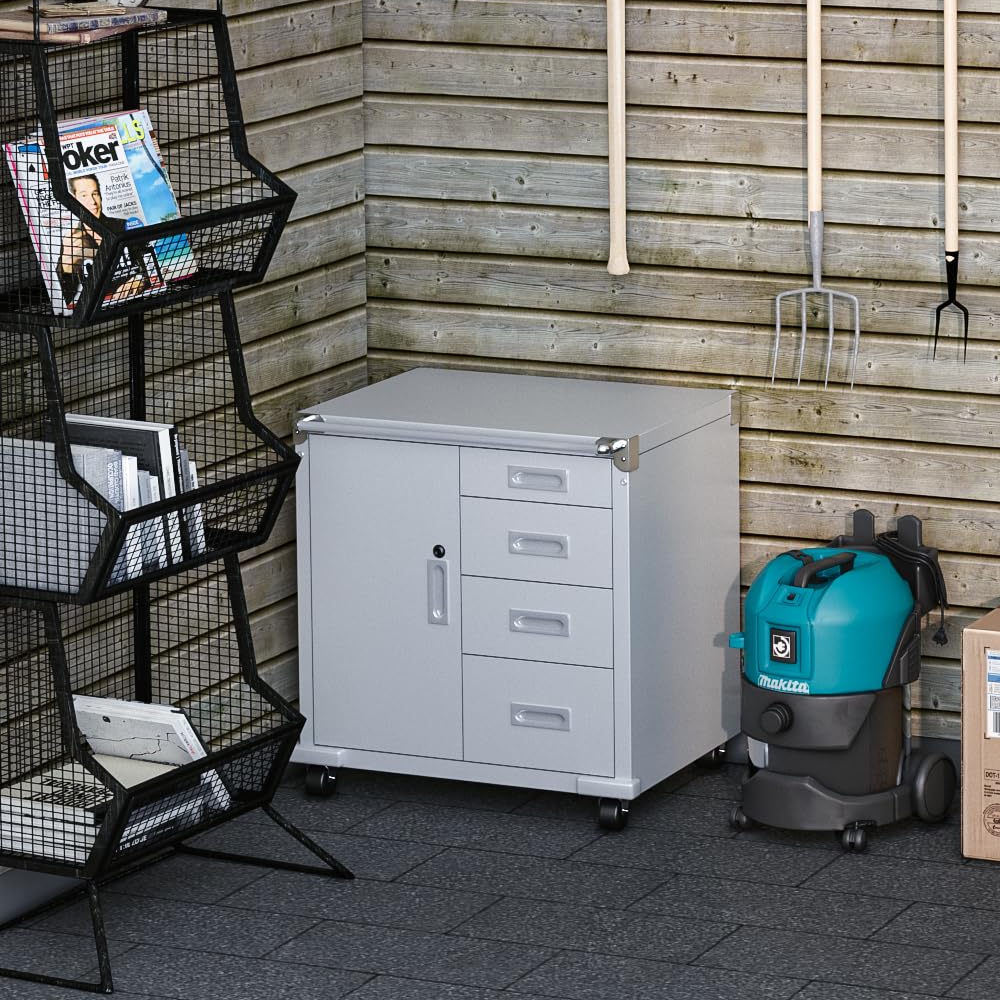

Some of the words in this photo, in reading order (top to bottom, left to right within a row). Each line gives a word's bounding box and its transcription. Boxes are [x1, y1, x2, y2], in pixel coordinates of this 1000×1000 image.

[62, 142, 74, 150] WPT
[61, 140, 119, 170] oker
[110, 173, 129, 183] Patrik
